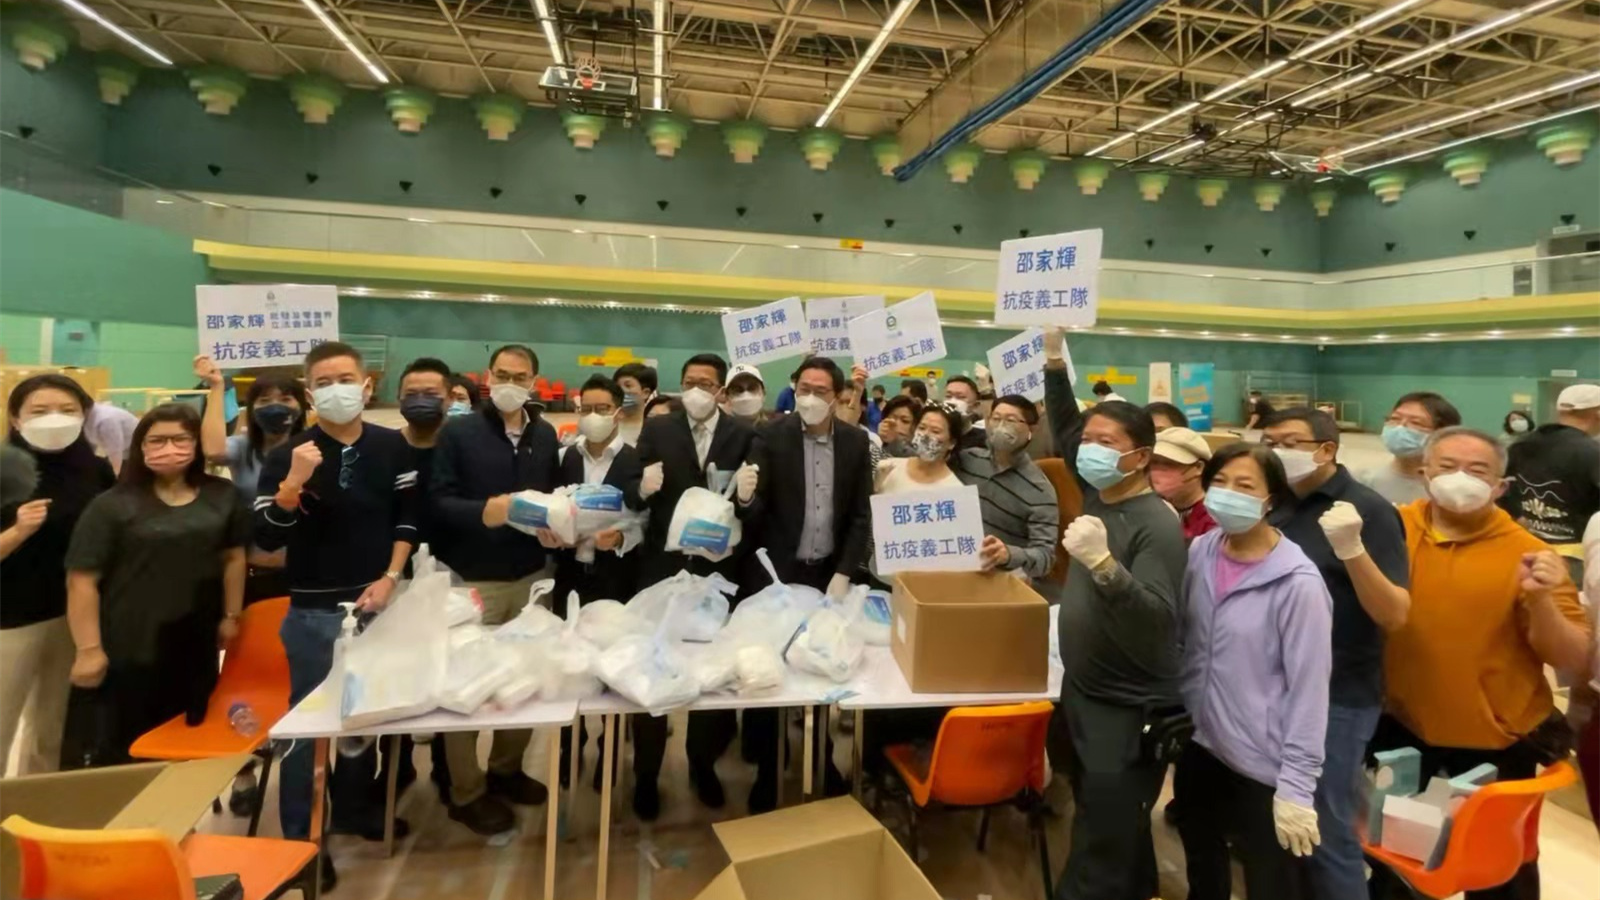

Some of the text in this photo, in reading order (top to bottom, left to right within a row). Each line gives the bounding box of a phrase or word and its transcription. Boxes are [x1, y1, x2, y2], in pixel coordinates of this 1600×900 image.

[1016, 246, 1077, 274] 邵家輝
[1003, 287, 1088, 311] 抗疫義工隊
[206, 314, 265, 329] 邵家輝
[738, 308, 787, 334] 邵家輝
[735, 331, 802, 359] 抗疫義工隊
[863, 337, 936, 371] 抗疫義工隊
[892, 500, 957, 525] 邵家輝
[884, 535, 977, 559] 抗疫義工隊
